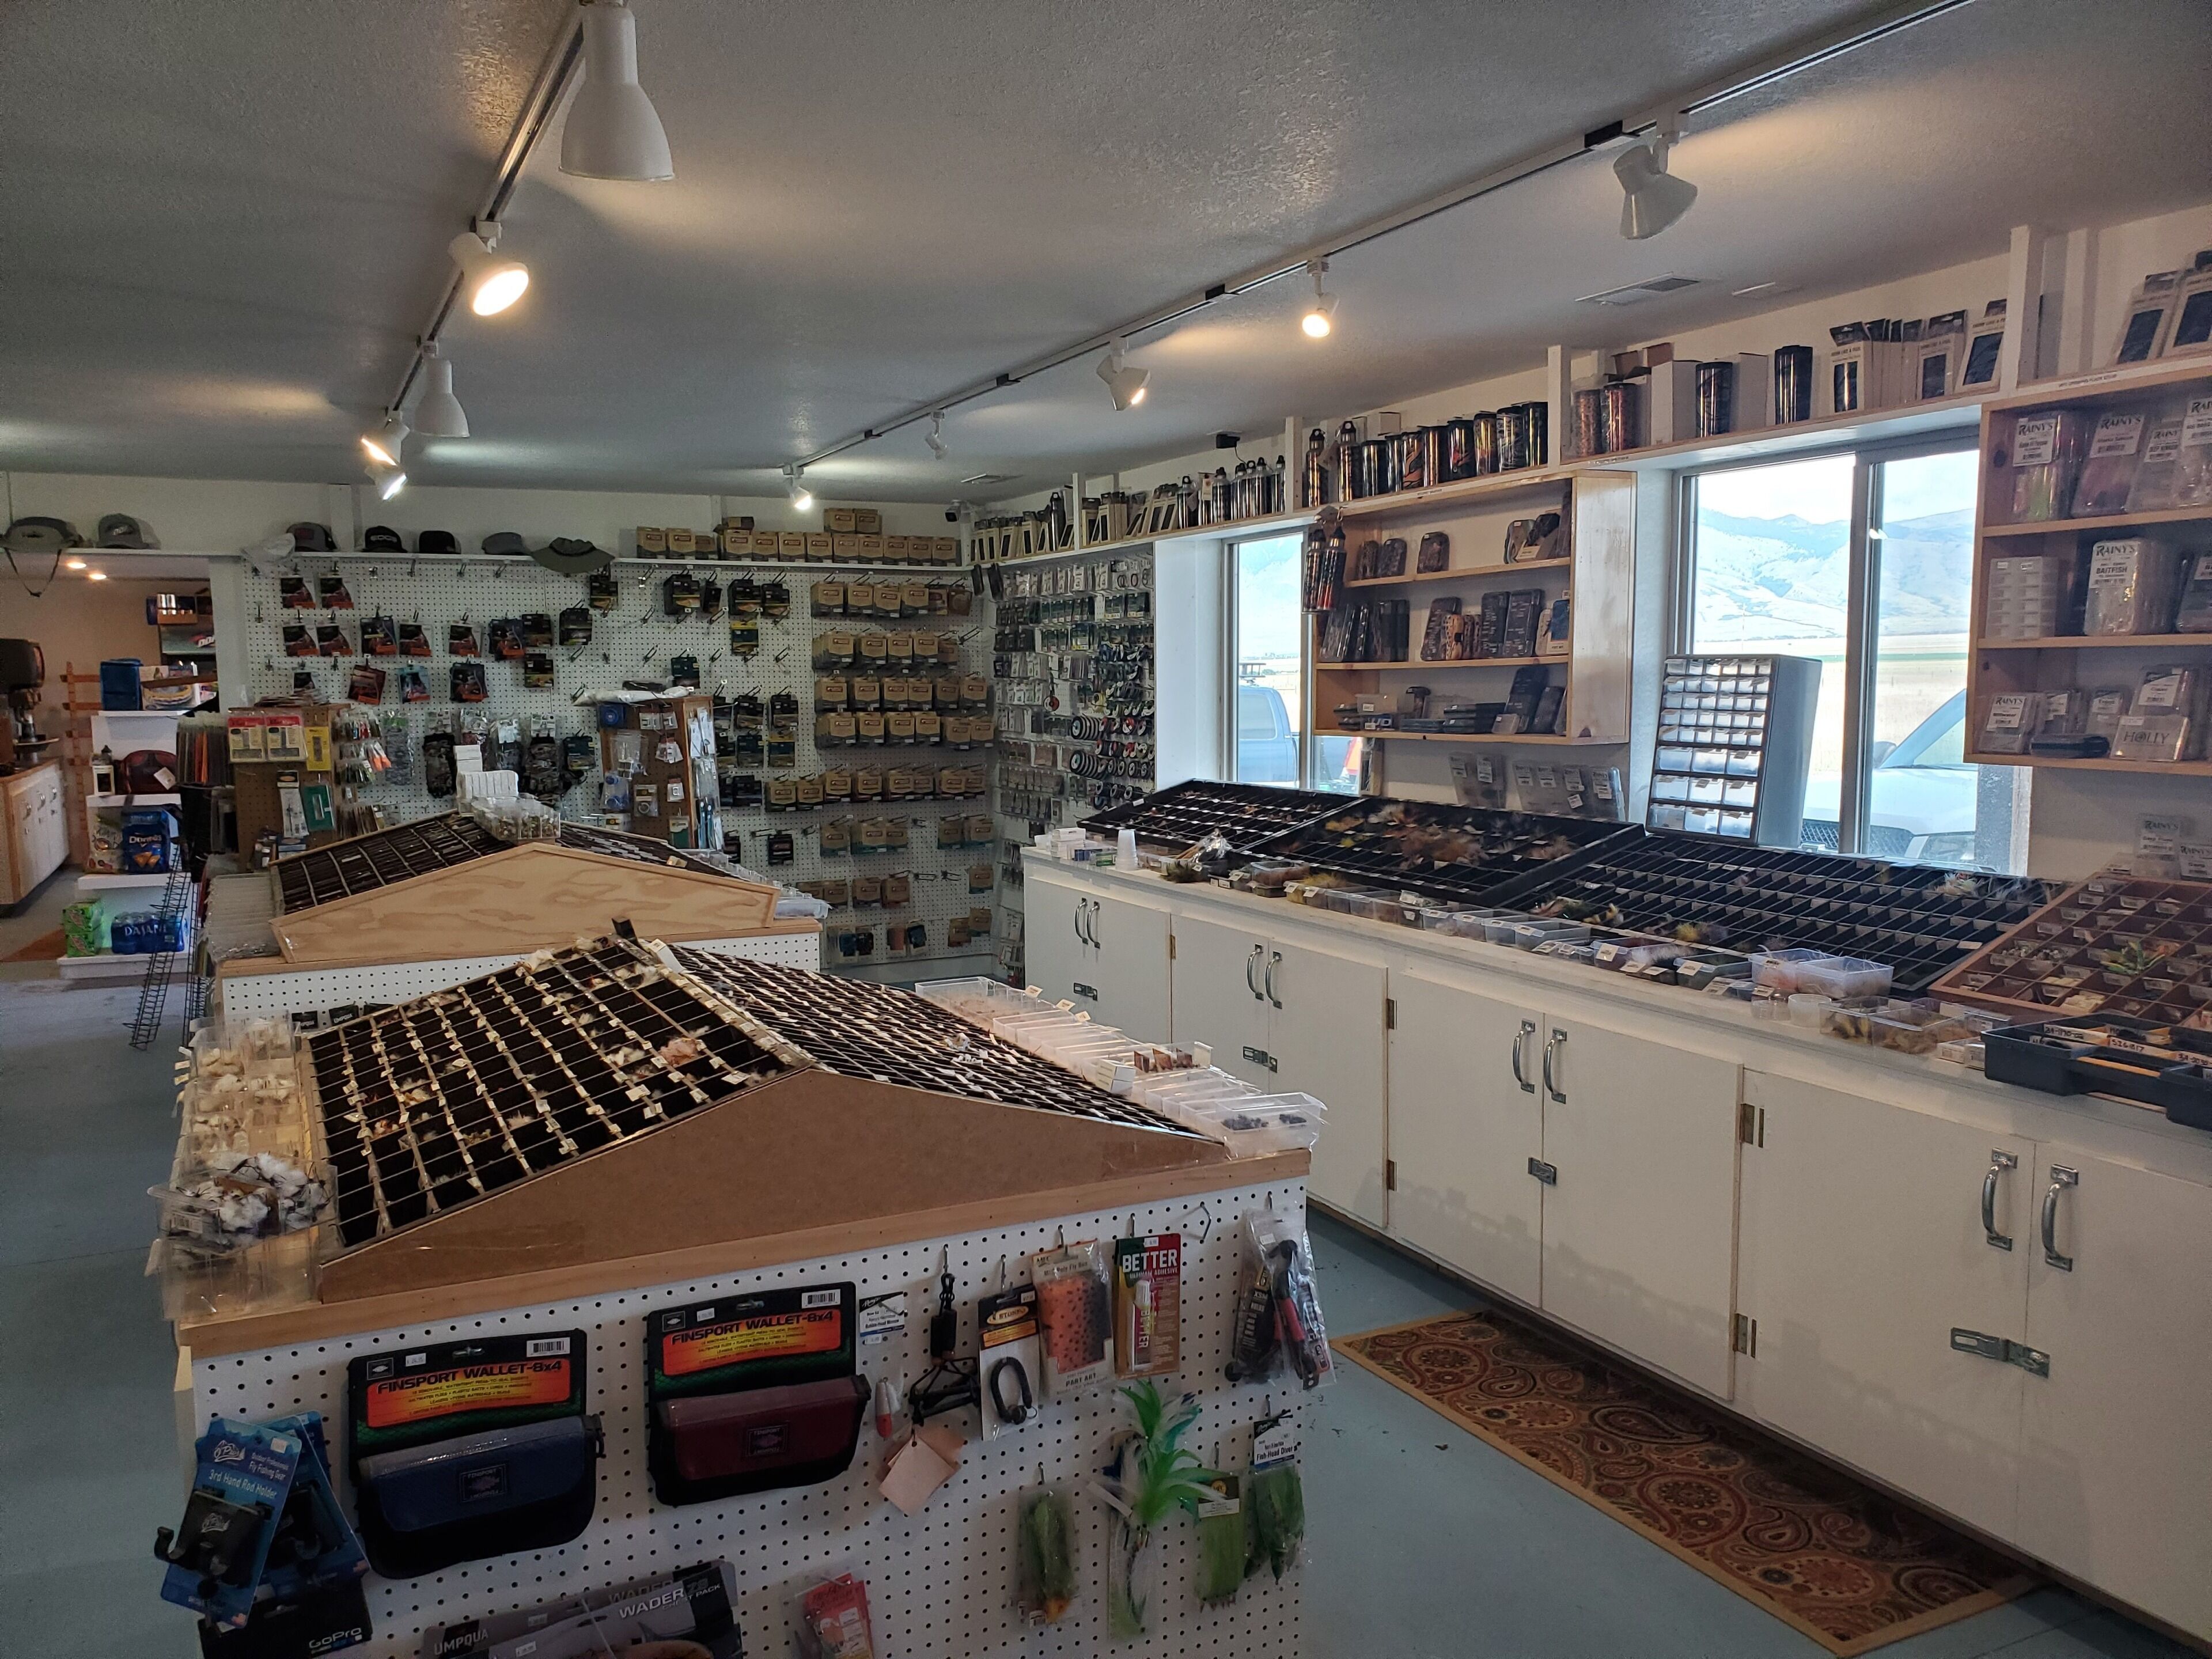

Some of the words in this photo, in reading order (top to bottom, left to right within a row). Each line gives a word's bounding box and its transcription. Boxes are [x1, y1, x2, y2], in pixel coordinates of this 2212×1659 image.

[2018, 422, 2054, 436] RAINY'S
[2096, 544, 2136, 557] RAINY'S
[2096, 566, 2128, 574] BAITFISH
[1122, 1248, 1177, 1272] BETTER
[1154, 1267, 1178, 1276] ADHESIVE
[672, 1321, 743, 1346] FINSPORT
[746, 1310, 834, 1330] WALLET-8x4
[377, 1371, 459, 1395] FINSPORT
[463, 1360, 563, 1380] WALLET-8x4
[1256, 1448, 1279, 1461] Fish-Head
[1281, 1446, 1293, 1455] Diver
[249, 1461, 257, 1472] Fly
[257, 1464, 275, 1479] Fishing
[275, 1470, 286, 1481] Gear
[209, 1469, 222, 1482] 3rd
[223, 1473, 241, 1488] Hand
[242, 1478, 255, 1493] Rod
[255, 1483, 278, 1499] Holder
[695, 1584, 721, 1598] PACK
[619, 1588, 684, 1619] WADER
[308, 1627, 362, 1649] GoPro
[433, 1628, 490, 1656] UMPQUA
